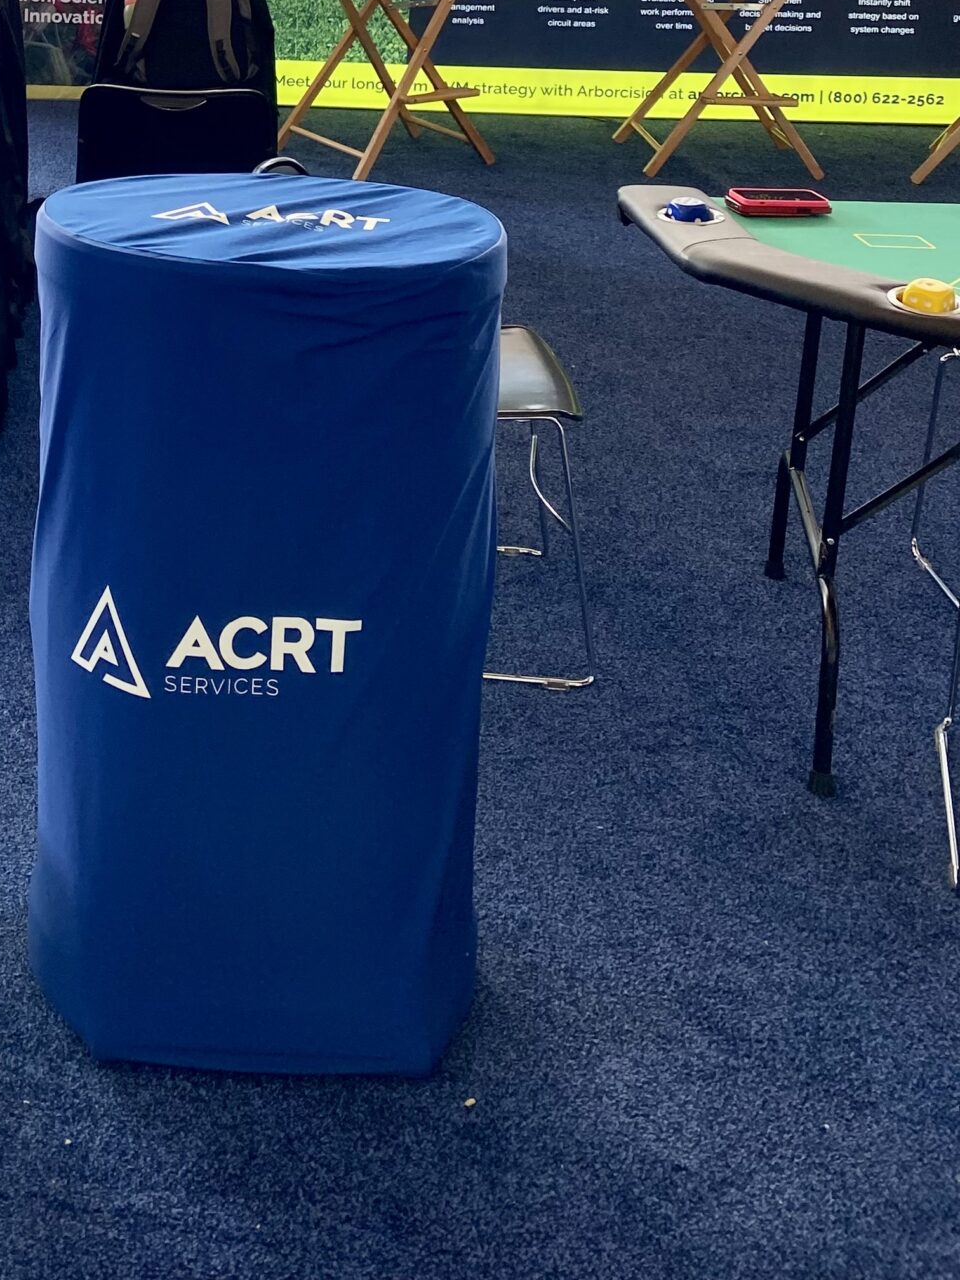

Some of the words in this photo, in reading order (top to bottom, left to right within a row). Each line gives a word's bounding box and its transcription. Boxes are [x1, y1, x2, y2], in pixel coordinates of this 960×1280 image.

[894, 0, 911, 7] shift
[537, 5, 565, 15] drivers
[567, 6, 582, 14] and
[584, 6, 609, 15] at-risk
[806, 11, 821, 19] and
[452, 17, 484, 26] analysis
[848, 12, 880, 22] strategy
[548, 19, 570, 27] circuit
[573, 20, 596, 28] areas
[675, 22, 692, 30] time
[850, 26, 879, 35] system
[881, 26, 915, 36] changes
[539, 85, 573, 98] with
[669, 89, 684, 100] at
[827, 91, 867, 106] (800)
[872, 91, 945, 106] 622-2562
[165, 615, 362, 673] ACRT
[164, 675, 279, 696] SERVICES
